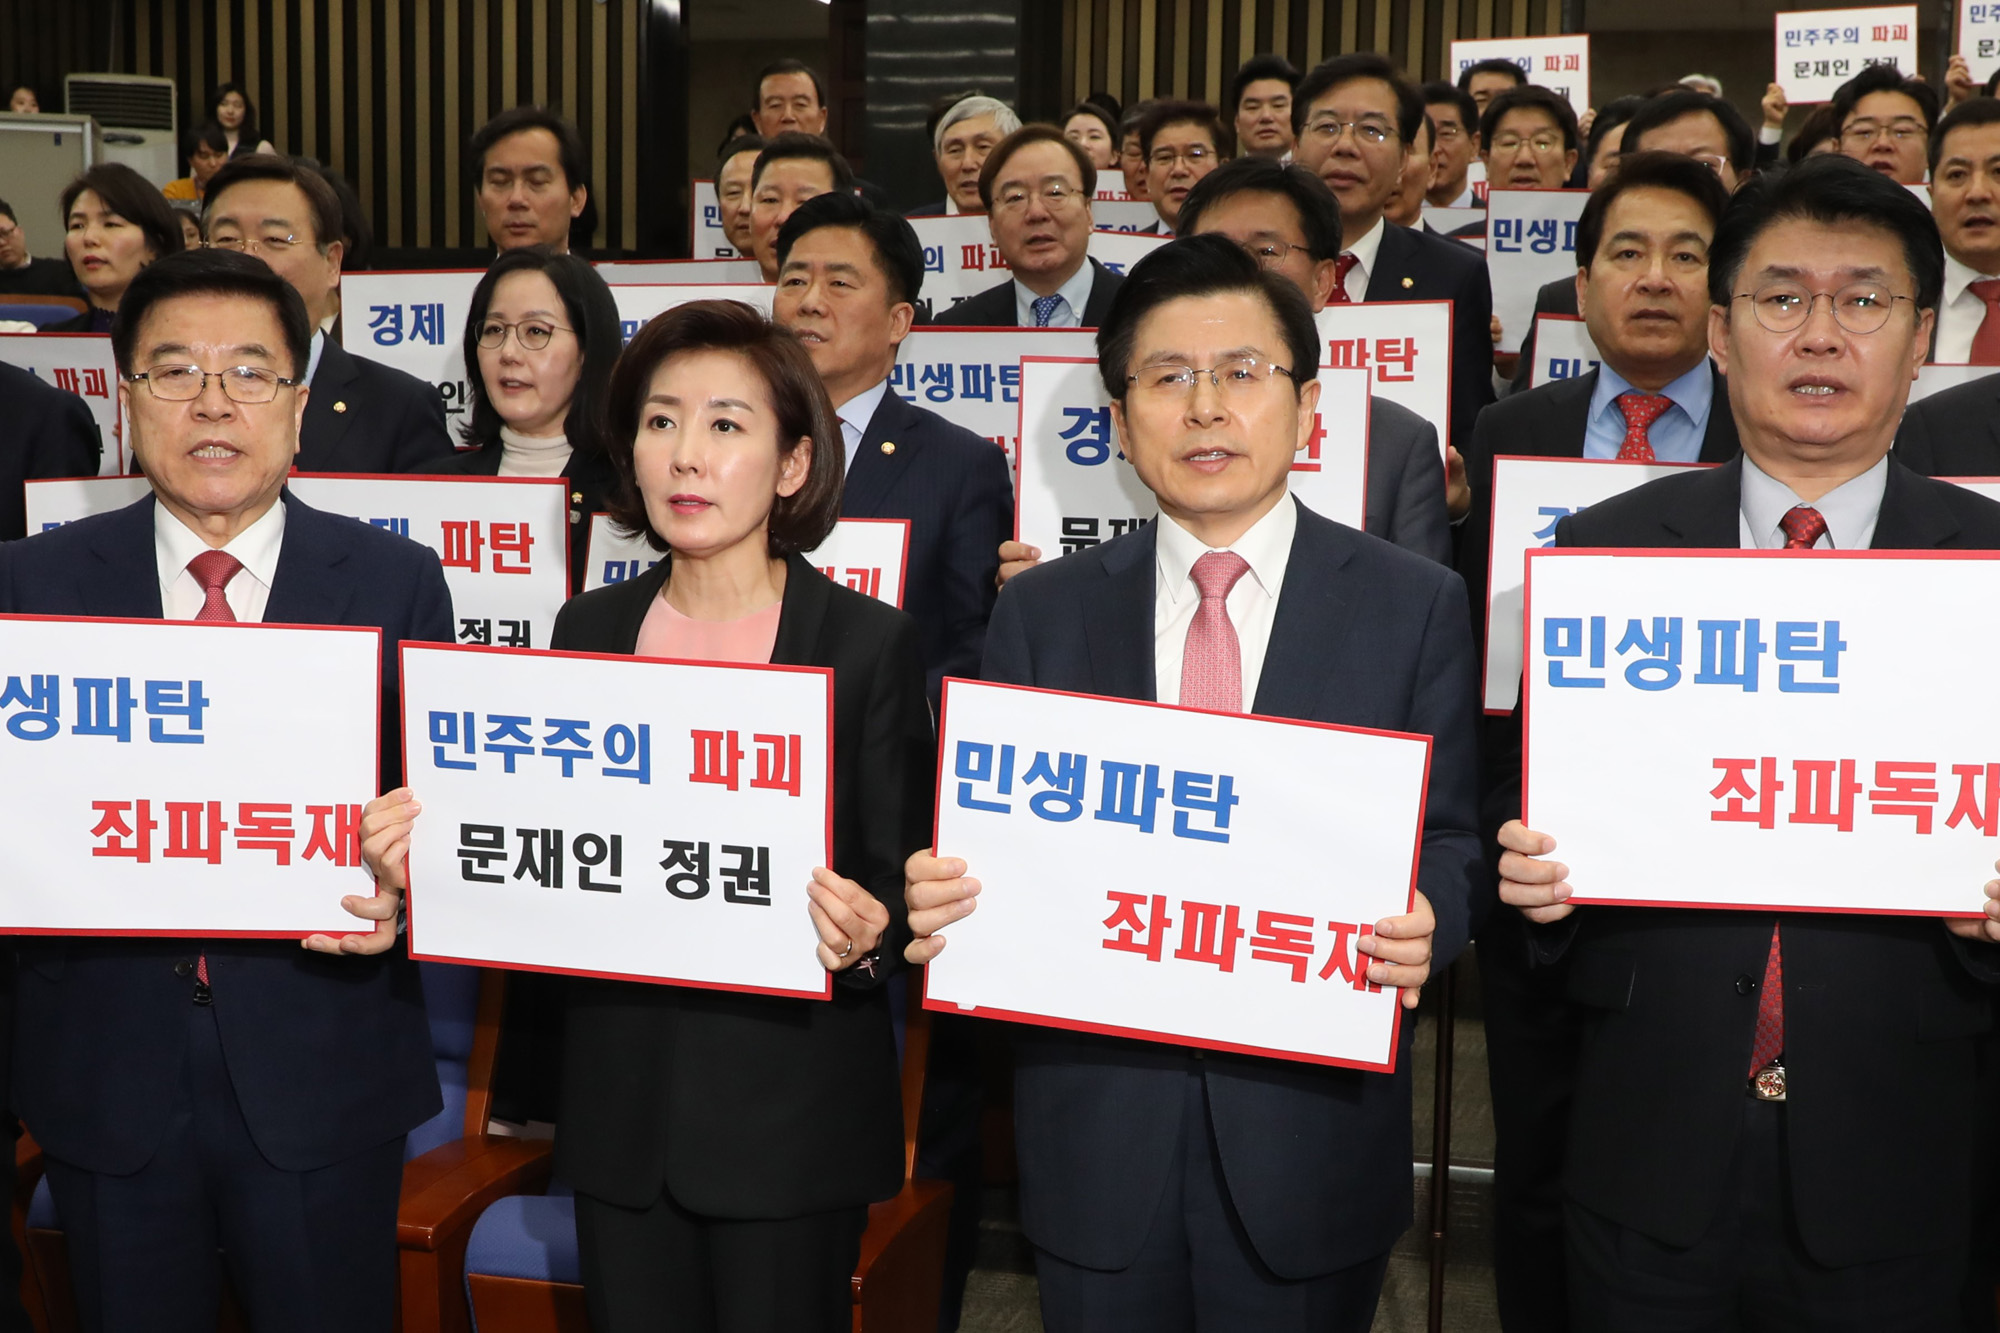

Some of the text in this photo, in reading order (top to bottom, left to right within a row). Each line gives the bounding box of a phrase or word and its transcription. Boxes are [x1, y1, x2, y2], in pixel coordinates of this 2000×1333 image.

[1544, 54, 1580, 72] 파괴
[1785, 24, 1909, 48] 민주주의 파괴
[1794, 58, 1850, 79] 문재인
[368, 303, 445, 347] 경제
[441, 520, 535, 574] 파탄
[1543, 616, 1847, 694] 민생파탄
[428, 710, 801, 797] 민주주의 파괴
[955, 740, 1240, 844] 민생파탄
[90, 799, 363, 867] 좌파독재
[457, 823, 772, 907] 문재인 정권
